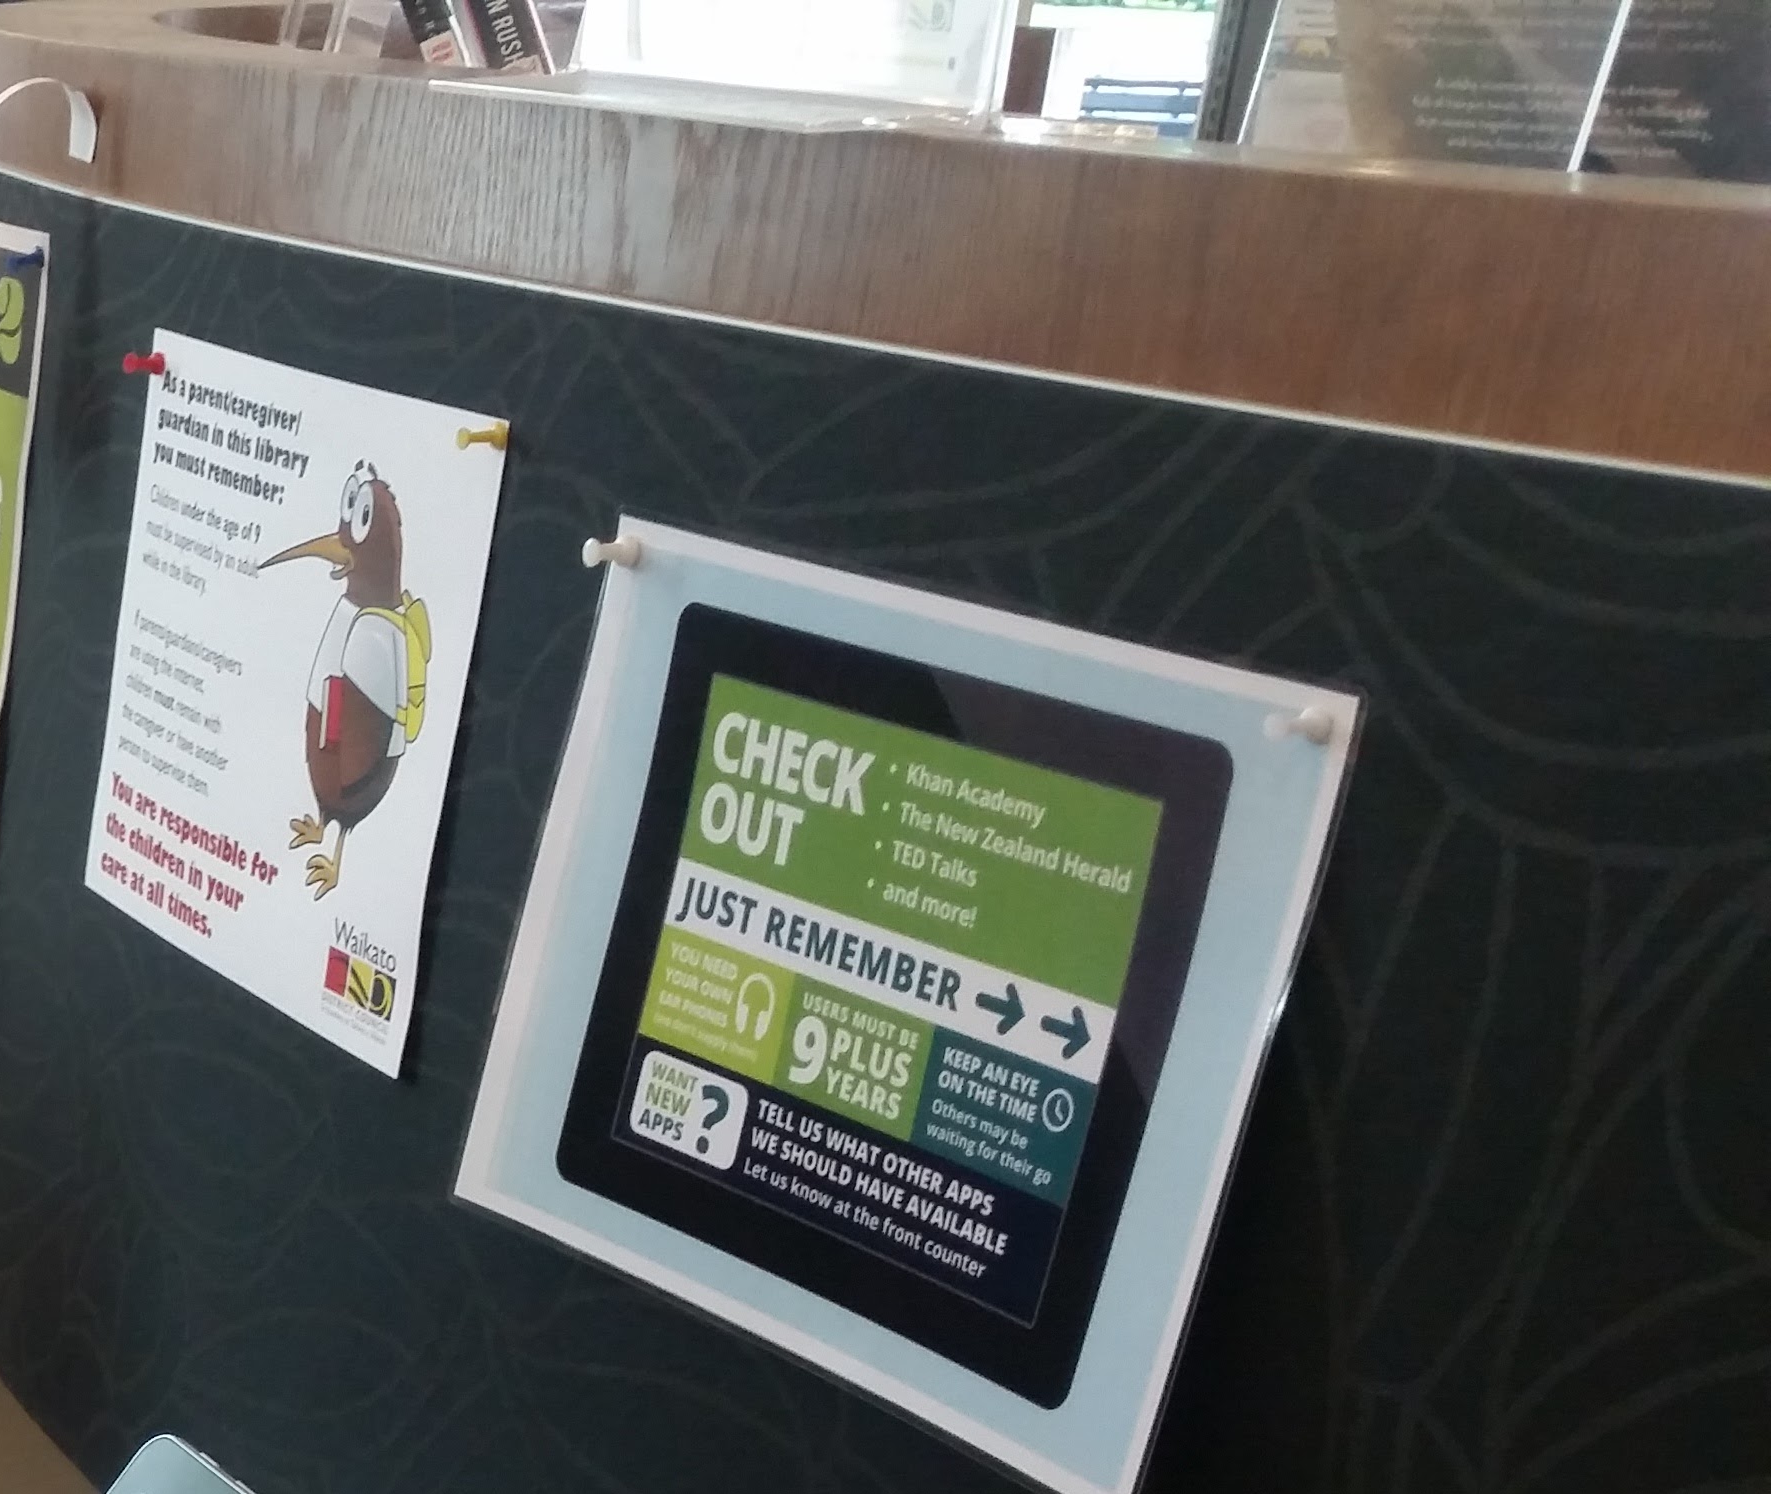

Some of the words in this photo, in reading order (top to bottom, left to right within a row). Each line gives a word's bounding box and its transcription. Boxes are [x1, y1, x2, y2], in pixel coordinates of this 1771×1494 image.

[492, 15, 525, 63] RUSH
[162, 370, 177, 394] As
[179, 379, 186, 397] a
[153, 442, 174, 465] you
[175, 450, 206, 478] must
[207, 462, 285, 505] remember:
[158, 408, 209, 442] guardian
[211, 422, 224, 447] in
[227, 428, 252, 457] this
[254, 436, 309, 478] library
[713, 712, 875, 815] CHECK
[700, 782, 804, 866] OUT
[906, 762, 953, 797] Khan
[958, 778, 1046, 829] Academy
[112, 771, 133, 806] You
[135, 792, 157, 821] are
[159, 806, 247, 871] responsible
[250, 851, 278, 886] for
[900, 801, 931, 831] The
[935, 811, 978, 845] New
[981, 827, 1060, 872] Zealand
[1062, 855, 1133, 894] Herald
[106, 812, 126, 843] the
[129, 828, 185, 880] children
[188, 860, 203, 891] in
[206, 874, 244, 912] your
[892, 839, 926, 869] TED
[931, 851, 978, 888] Talks
[101, 852, 128, 885] care
[130, 871, 145, 896] at
[146, 881, 165, 909] all
[167, 892, 212, 939] times.
[883, 881, 919, 911] and
[921, 895, 979, 930] more!
[335, 917, 397, 973] Waikato
[671, 942, 700, 966] YOU
[674, 877, 758, 935] JUST
[764, 906, 962, 1012] REMEMBER
[787, 1016, 828, 1084] 9
[803, 992, 850, 1023] USERS
[853, 1006, 897, 1039] MUST
[899, 1025, 920, 1050] BE
[650, 1061, 699, 1092] WANT
[831, 1027, 912, 1088] PLUS
[942, 1046, 982, 1072] KEEP
[982, 1061, 1009, 1084] AN
[1010, 1073, 1040, 1098] EYE
[638, 1108, 684, 1141] APPS
[645, 1082, 692, 1117] NEW
[695, 1084, 730, 1155] ?
[826, 1066, 902, 1121] YEARS
[932, 1098, 978, 1130] Others
[979, 1120, 1009, 1147] may
[1010, 1128, 1029, 1149] be
[938, 1070, 964, 1093] ON
[965, 1081, 997, 1107] THE
[998, 1094, 1038, 1124] TIME
[757, 1099, 795, 1131] TELL
[798, 1118, 823, 1143] US
[826, 1127, 881, 1168] WHAT
[882, 1151, 942, 1195] OTHER
[944, 1179, 995, 1217] APPS
[926, 1121, 974, 1157] waiting
[975, 1137, 998, 1161] for
[998, 1149, 1033, 1176] their
[1033, 1166, 1052, 1187] go
[743, 1157, 768, 1179] Let
[770, 1171, 788, 1190] us
[790, 1176, 832, 1209] know
[833, 1197, 851, 1218] at
[854, 1206, 880, 1231] the
[882, 1220, 922, 1251] front
[923, 1238, 987, 1279] counter
[751, 1126, 779, 1152] WE
[779, 1140, 853, 1186] SHOULD
[855, 1171, 905, 1209] HAVE
[905, 1192, 1008, 1257] AVAILABLE
